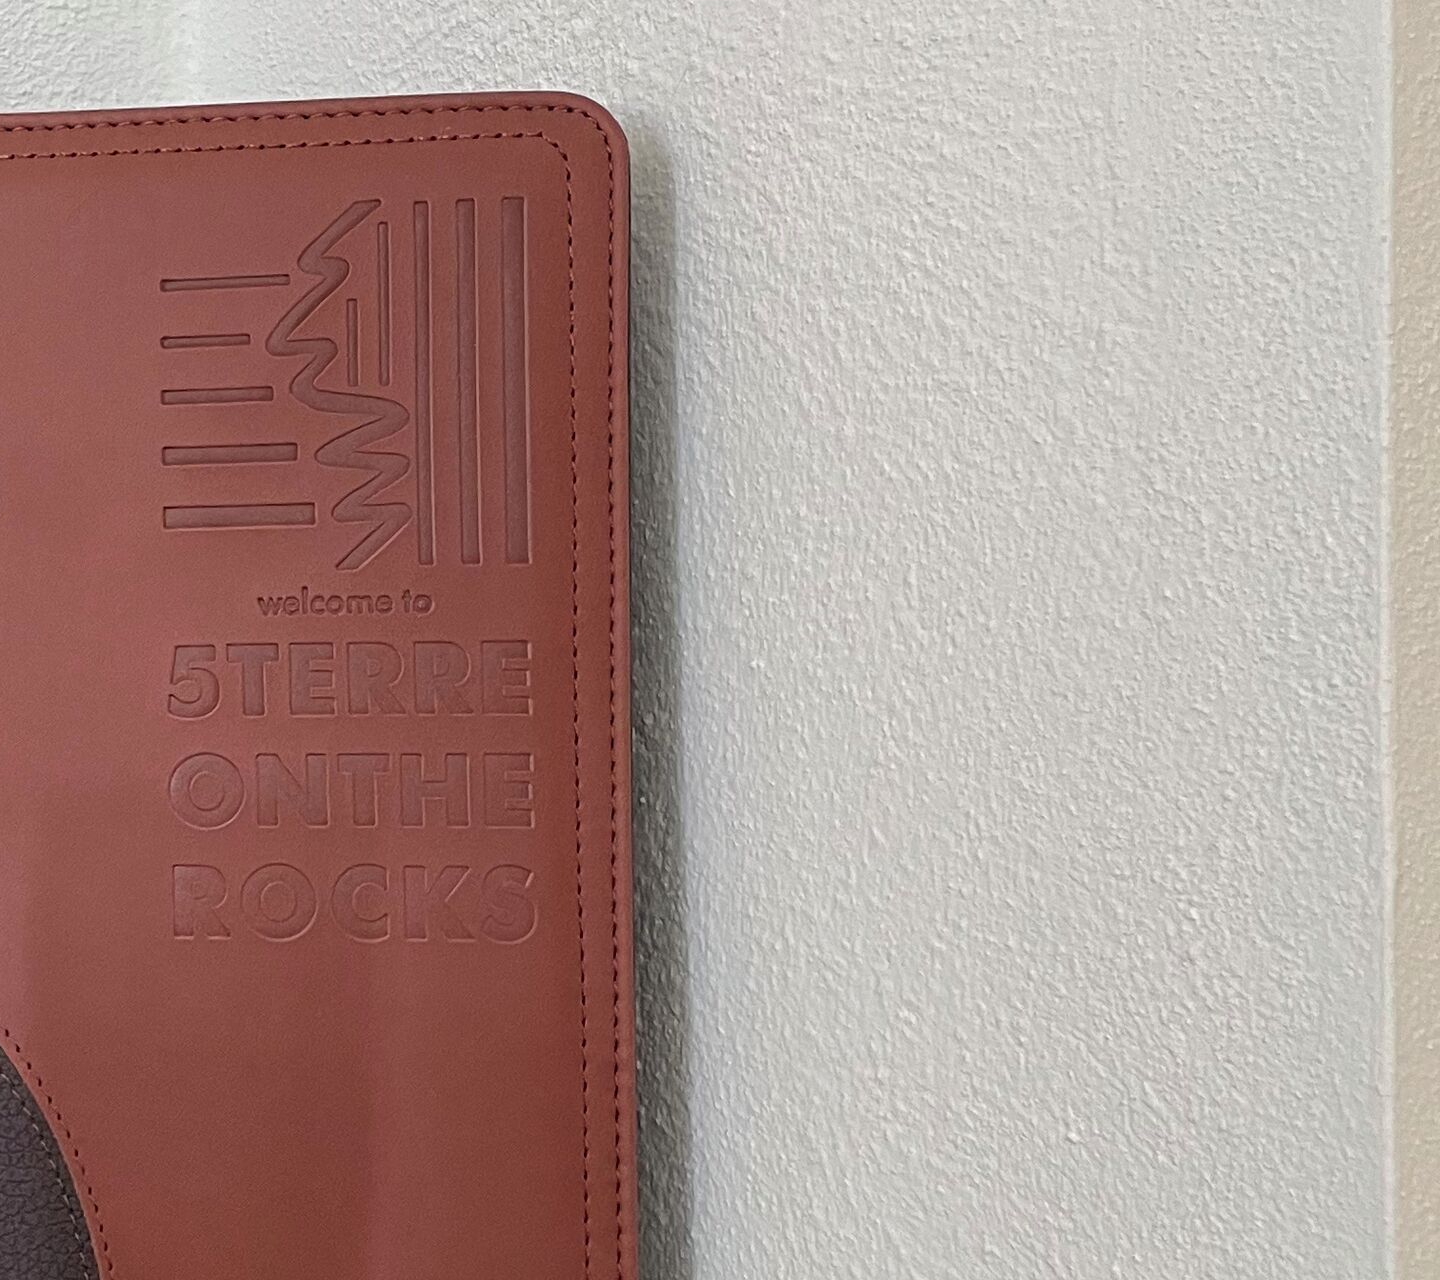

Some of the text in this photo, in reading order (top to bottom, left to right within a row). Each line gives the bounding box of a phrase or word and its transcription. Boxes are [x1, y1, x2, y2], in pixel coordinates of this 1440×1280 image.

[257, 586, 435, 617] welcome to
[166, 639, 534, 719] 5TERRE
[168, 751, 535, 830] ONTHE
[171, 862, 539, 944] ROCKS
